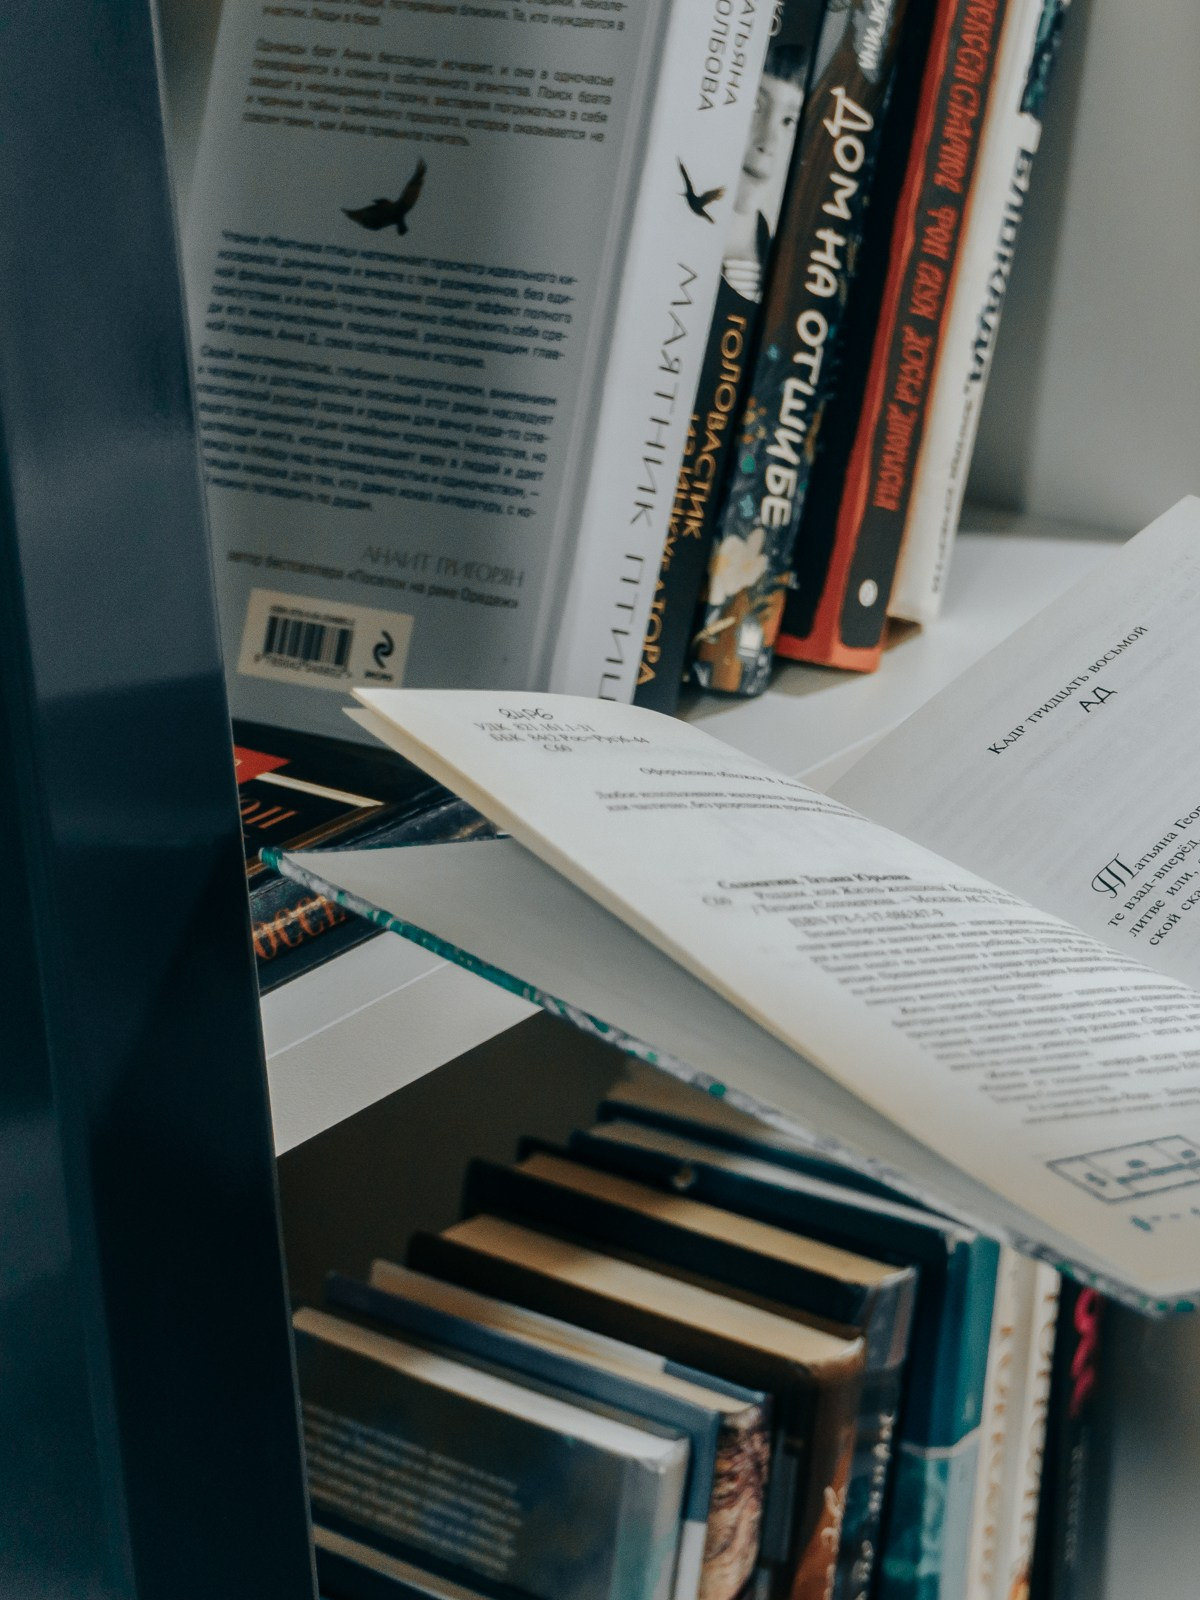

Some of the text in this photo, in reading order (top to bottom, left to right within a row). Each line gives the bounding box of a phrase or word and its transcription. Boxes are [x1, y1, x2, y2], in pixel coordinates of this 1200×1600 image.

[697, 0, 727, 111] ОЛБОВА
[722, 0, 758, 107] АТЬЯНА
[858, 0, 892, 70] ЯГИНА
[760, 87, 874, 528] ДОМ НА ОТШИБЕ
[629, 262, 698, 526] МАЯТНИК
[681, 314, 749, 539] ГОЛОВАСТИК
[1079, 686, 1118, 713] АД
[1091, 832, 1179, 899] Татьяна
[1107, 912, 1125, 927] те
[1128, 899, 1166, 938] литве
[1165, 871, 1200, 896] или,
[1149, 913, 1182, 946] ской
